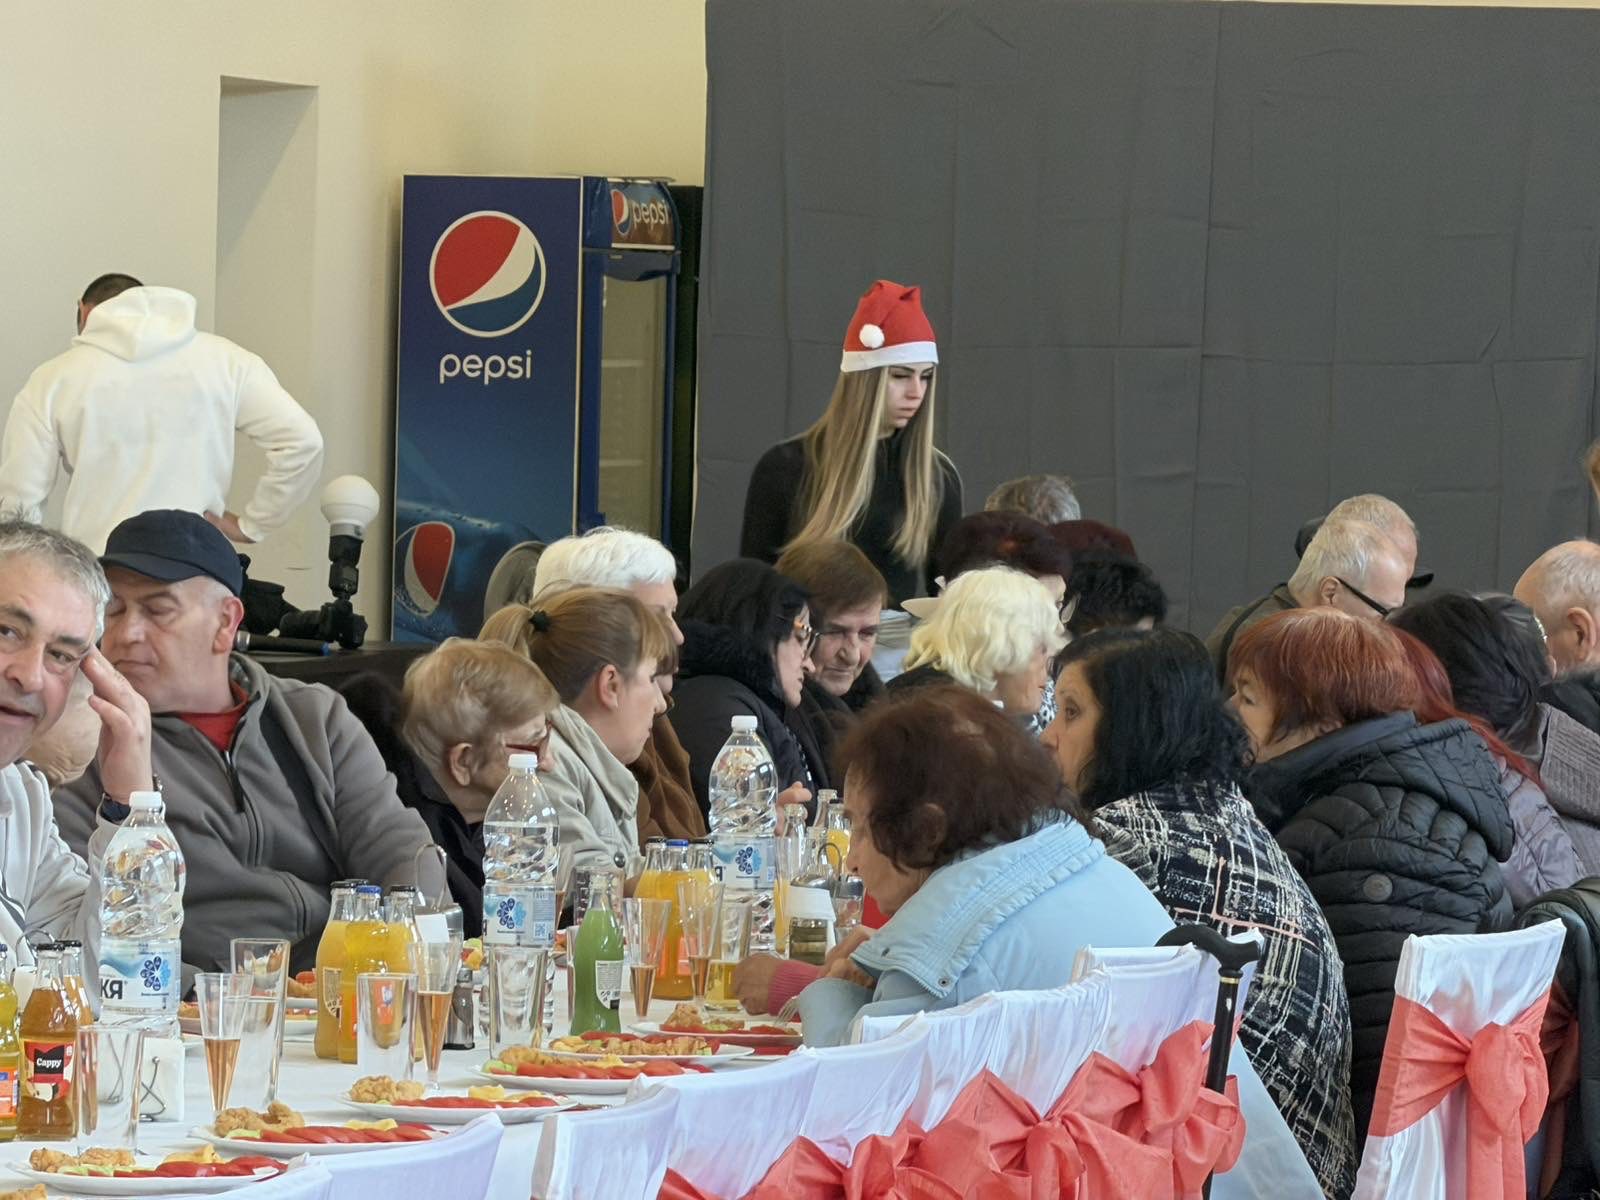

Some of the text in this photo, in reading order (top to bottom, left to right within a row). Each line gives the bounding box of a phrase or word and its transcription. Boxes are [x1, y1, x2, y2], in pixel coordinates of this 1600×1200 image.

[632, 198, 669, 231] pepsi
[439, 349, 532, 385] pepsi
[36, 1057, 62, 1068] Cappy
